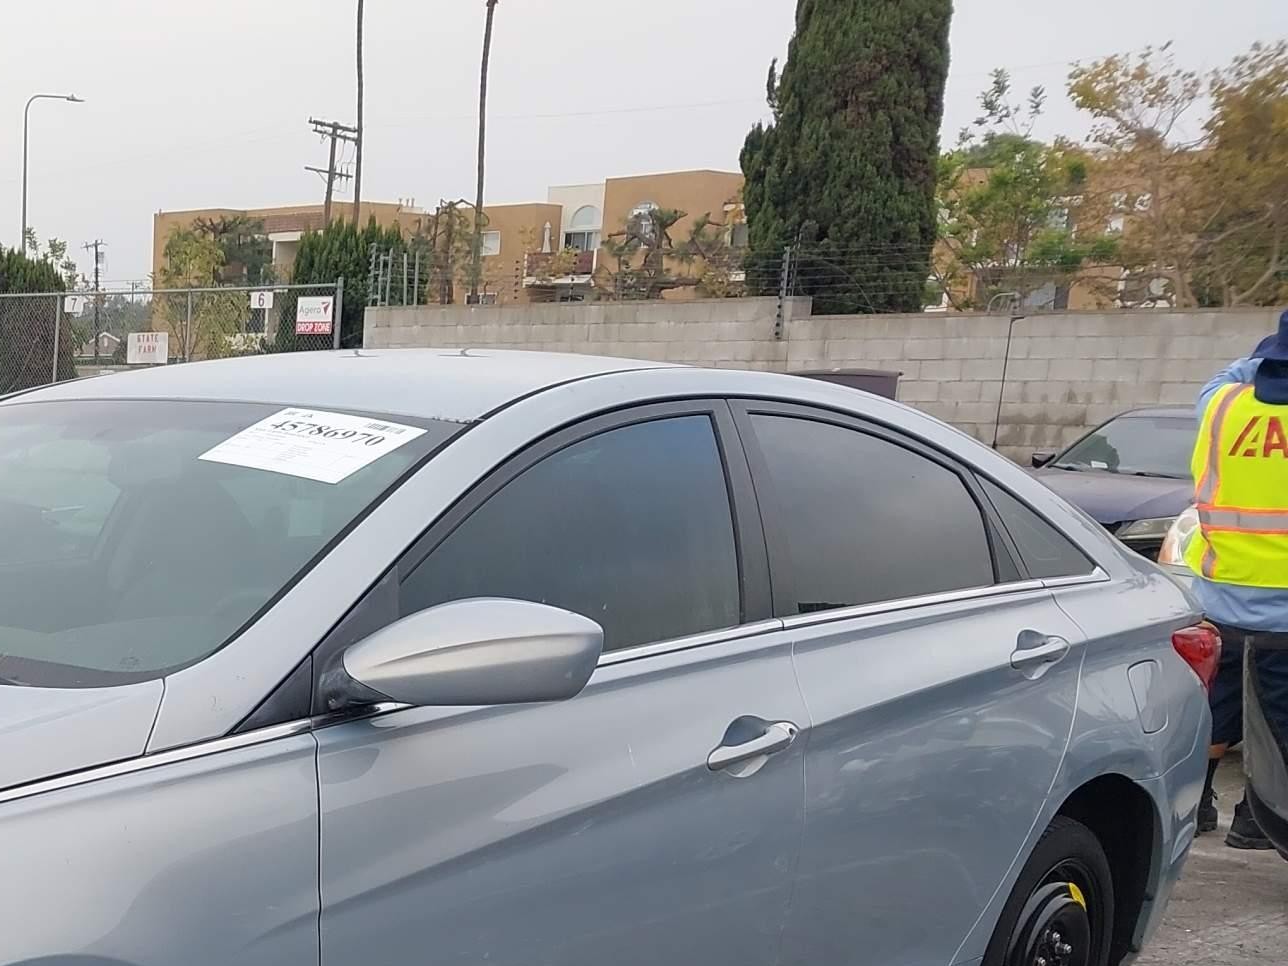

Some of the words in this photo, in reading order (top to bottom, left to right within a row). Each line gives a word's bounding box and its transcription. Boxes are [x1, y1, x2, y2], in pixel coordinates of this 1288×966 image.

[71, 297, 78, 310] 7
[258, 292, 265, 307] 6
[299, 304, 322, 317] Agero
[297, 323, 312, 332] DROP
[314, 323, 331, 332] ZONE
[137, 334, 159, 342] STATE
[138, 344, 158, 352] FARM
[272, 420, 385, 446] 45786970
